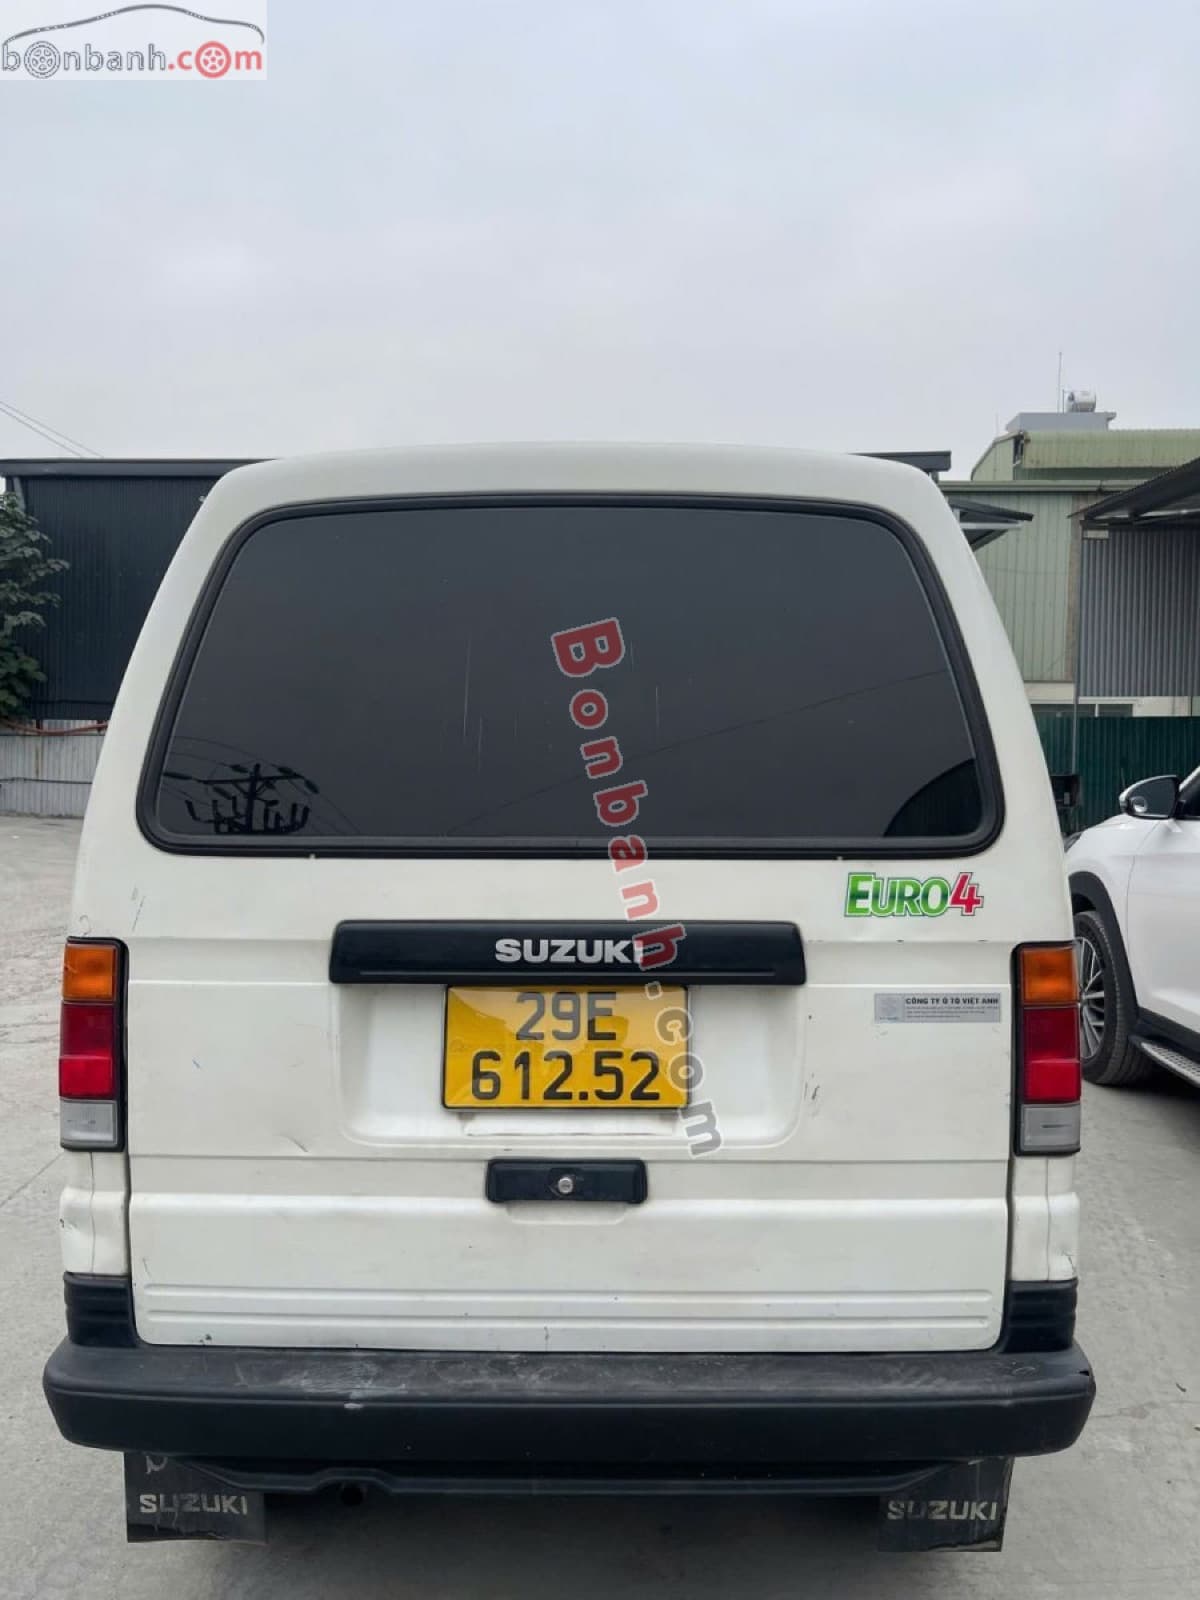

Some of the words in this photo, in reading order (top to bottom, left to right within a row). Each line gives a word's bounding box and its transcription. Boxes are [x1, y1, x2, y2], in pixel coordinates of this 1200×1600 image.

[845, 872, 985, 917] EURO4
[516, 991, 617, 1041] 29E
[930, 997, 940, 1005] TY
[471, 1050, 661, 1100] 612.52
[139, 1494, 248, 1515] SUZUKI
[887, 1500, 998, 1520] SUZUKI
